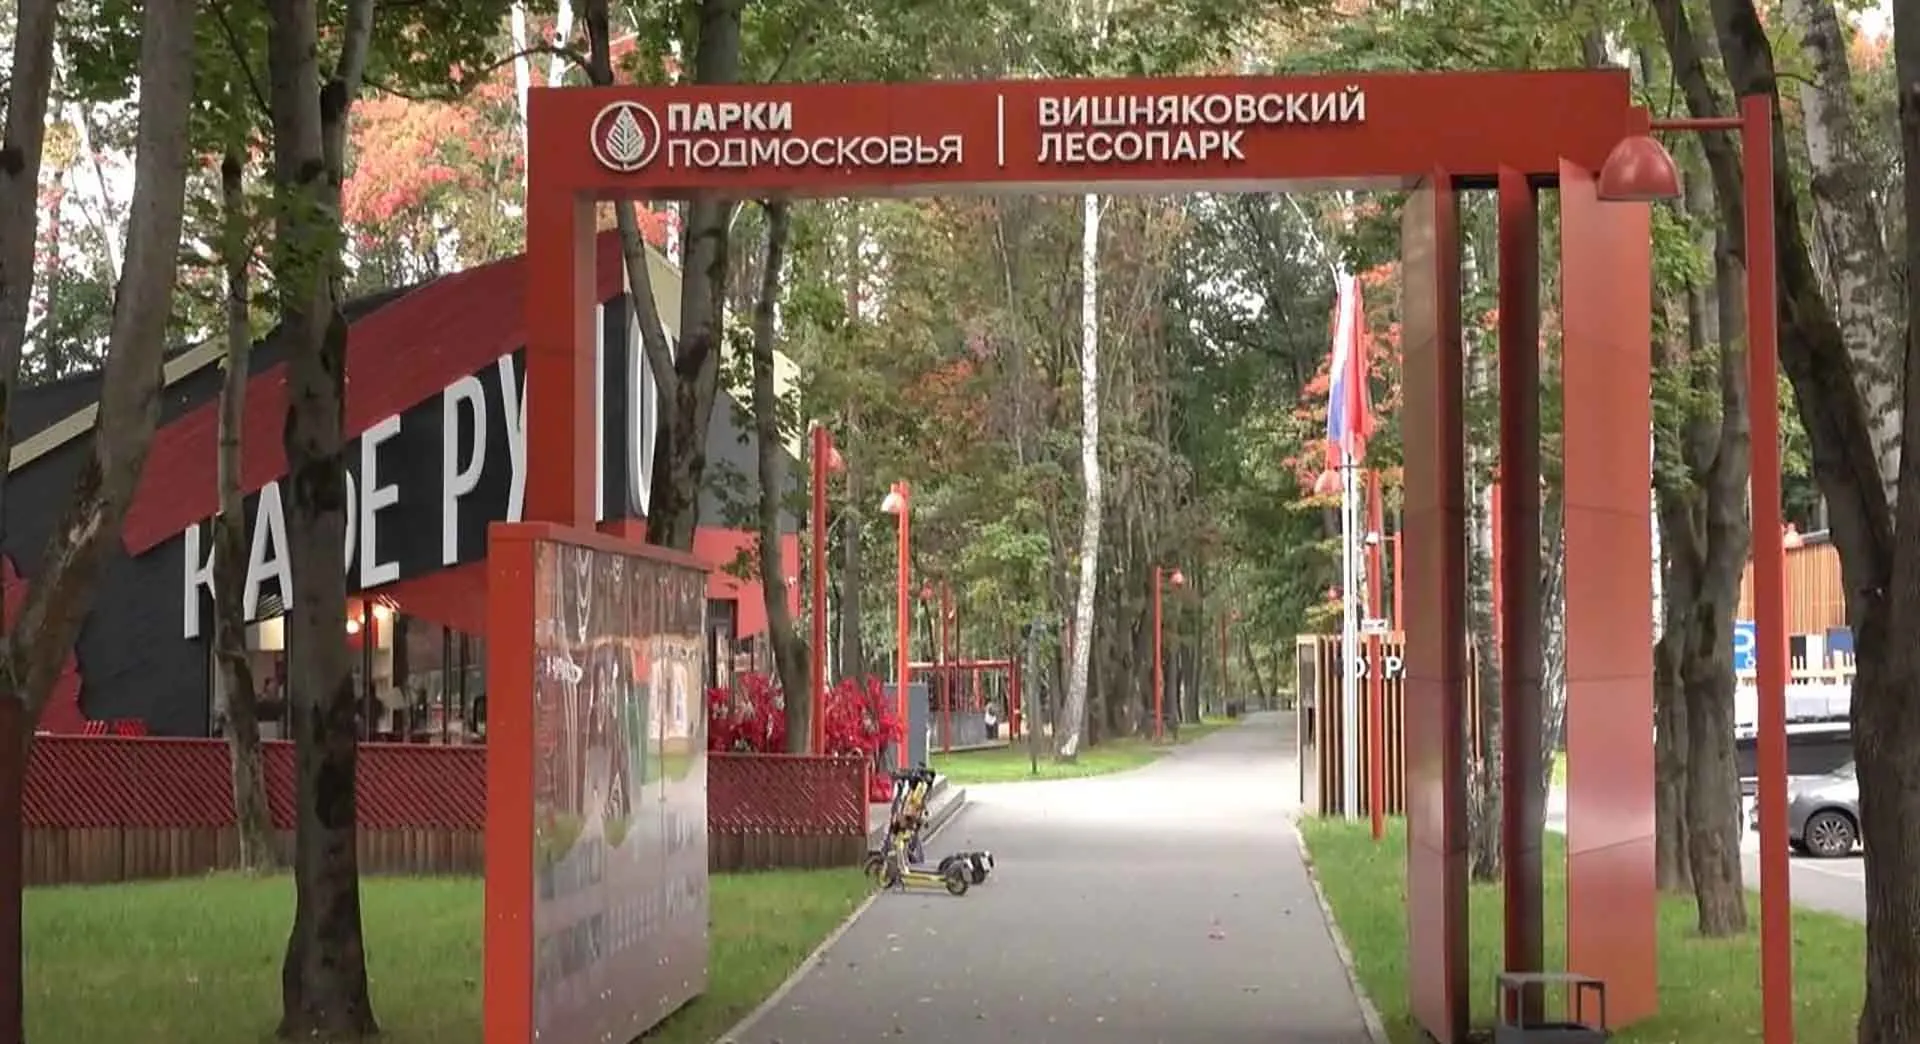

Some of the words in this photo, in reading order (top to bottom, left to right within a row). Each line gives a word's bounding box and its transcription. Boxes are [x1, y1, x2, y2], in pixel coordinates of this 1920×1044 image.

[668, 102, 792, 131] ПАРКИ
[1039, 85, 1365, 126] ВИШНЯКОВСКИЙ
[668, 135, 963, 168] ПОДМОСКОВЬЯ
[1038, 130, 1246, 162] ЛЕСОПАРК
[184, 414, 400, 639] КАЕ
